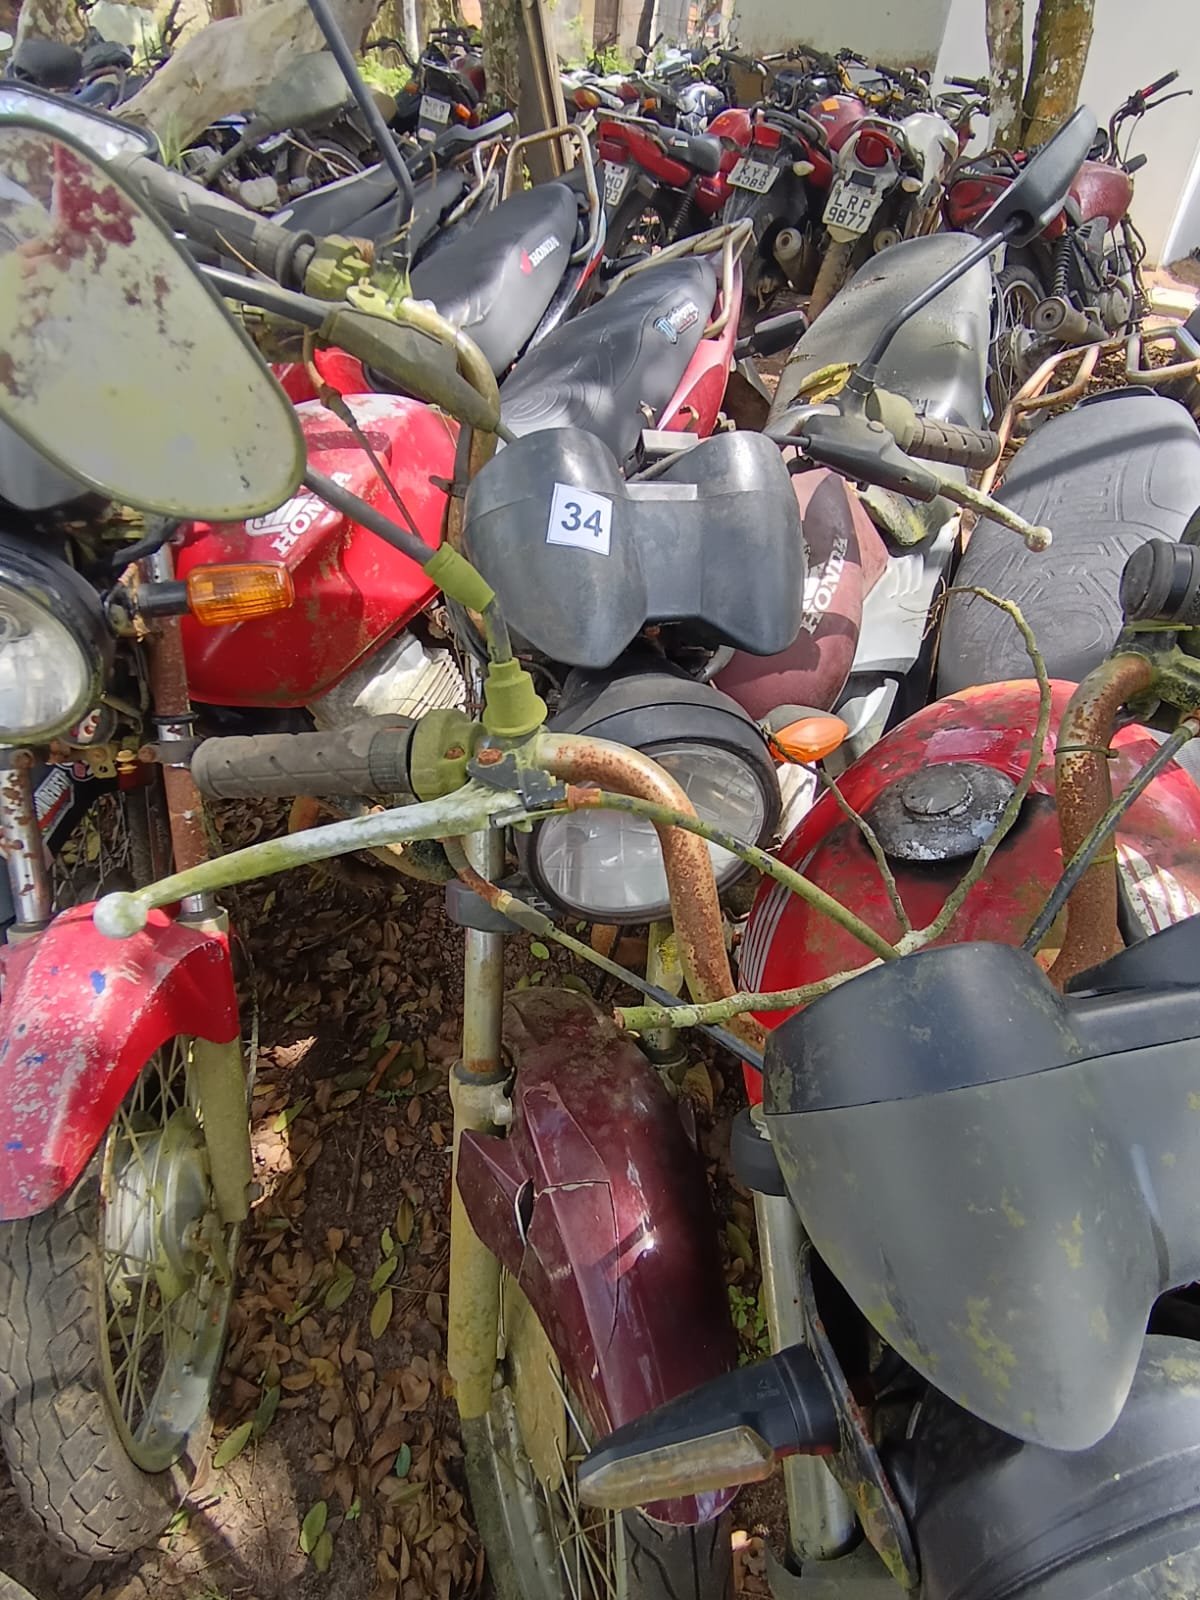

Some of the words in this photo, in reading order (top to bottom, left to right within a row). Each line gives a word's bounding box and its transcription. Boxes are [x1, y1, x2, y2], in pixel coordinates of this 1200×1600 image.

[827, 206, 867, 229] 9877
[834, 189, 871, 213] LRP
[528, 235, 560, 267] HONDA
[269, 471, 353, 558] HONA
[560, 501, 603, 538] 34
[800, 537, 849, 635] HONDA
